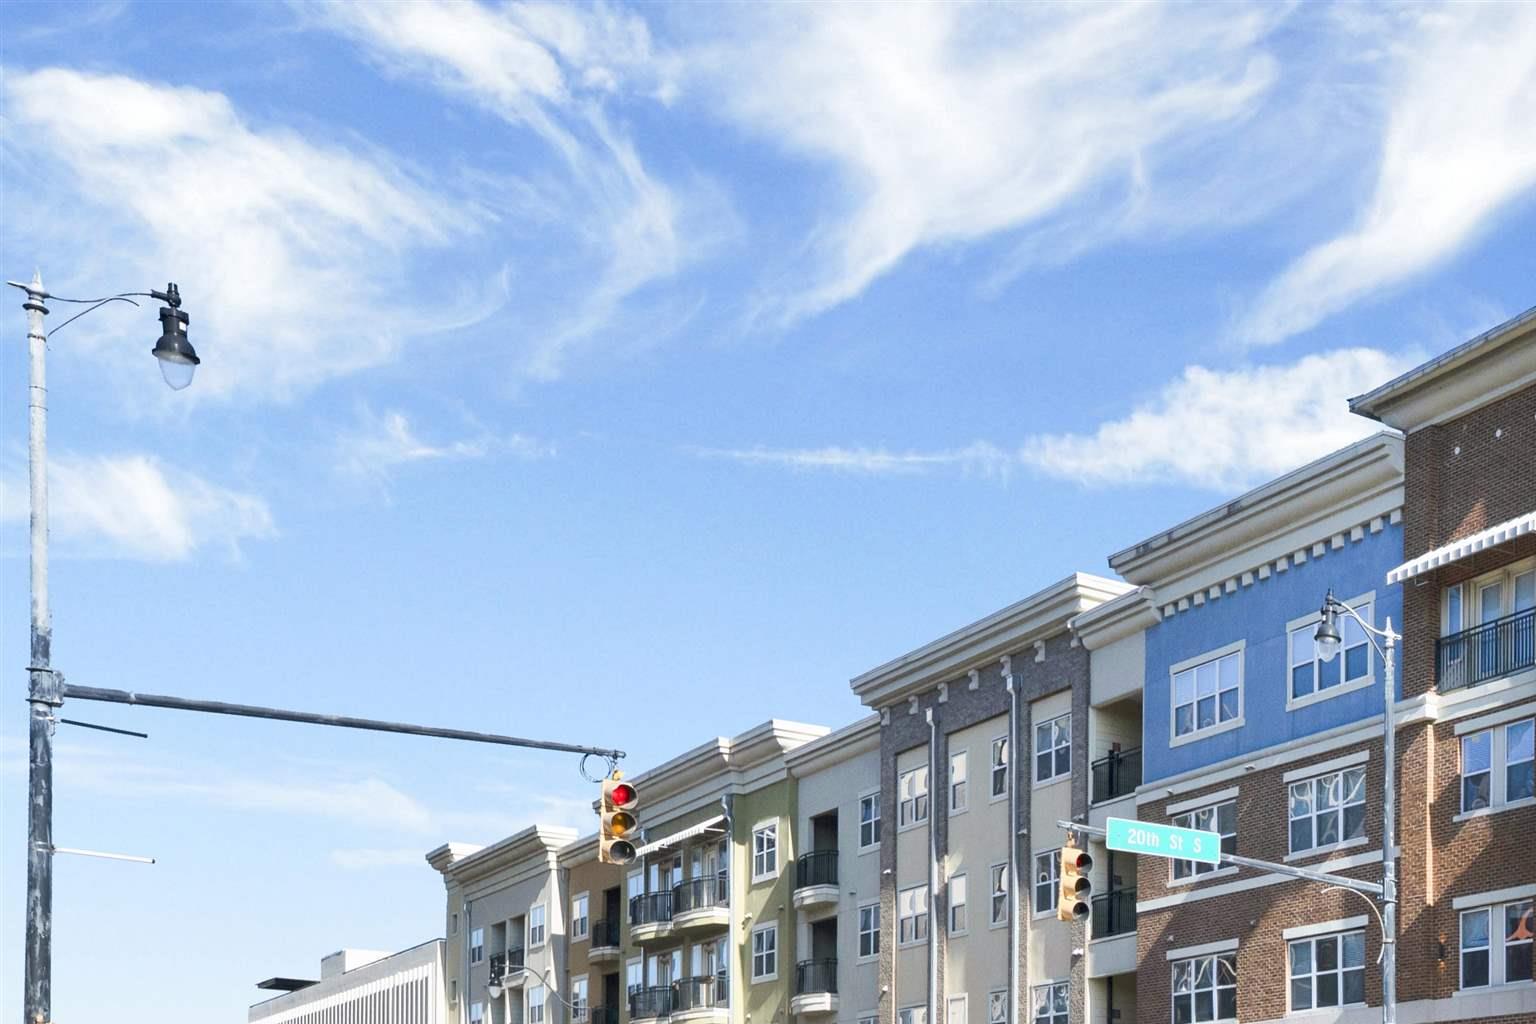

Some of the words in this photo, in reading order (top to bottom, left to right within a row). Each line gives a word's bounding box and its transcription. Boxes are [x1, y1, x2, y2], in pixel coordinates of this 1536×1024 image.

[1127, 828, 1160, 848] 20th
[1169, 833, 1184, 851] St
[1192, 837, 1202, 853] S
